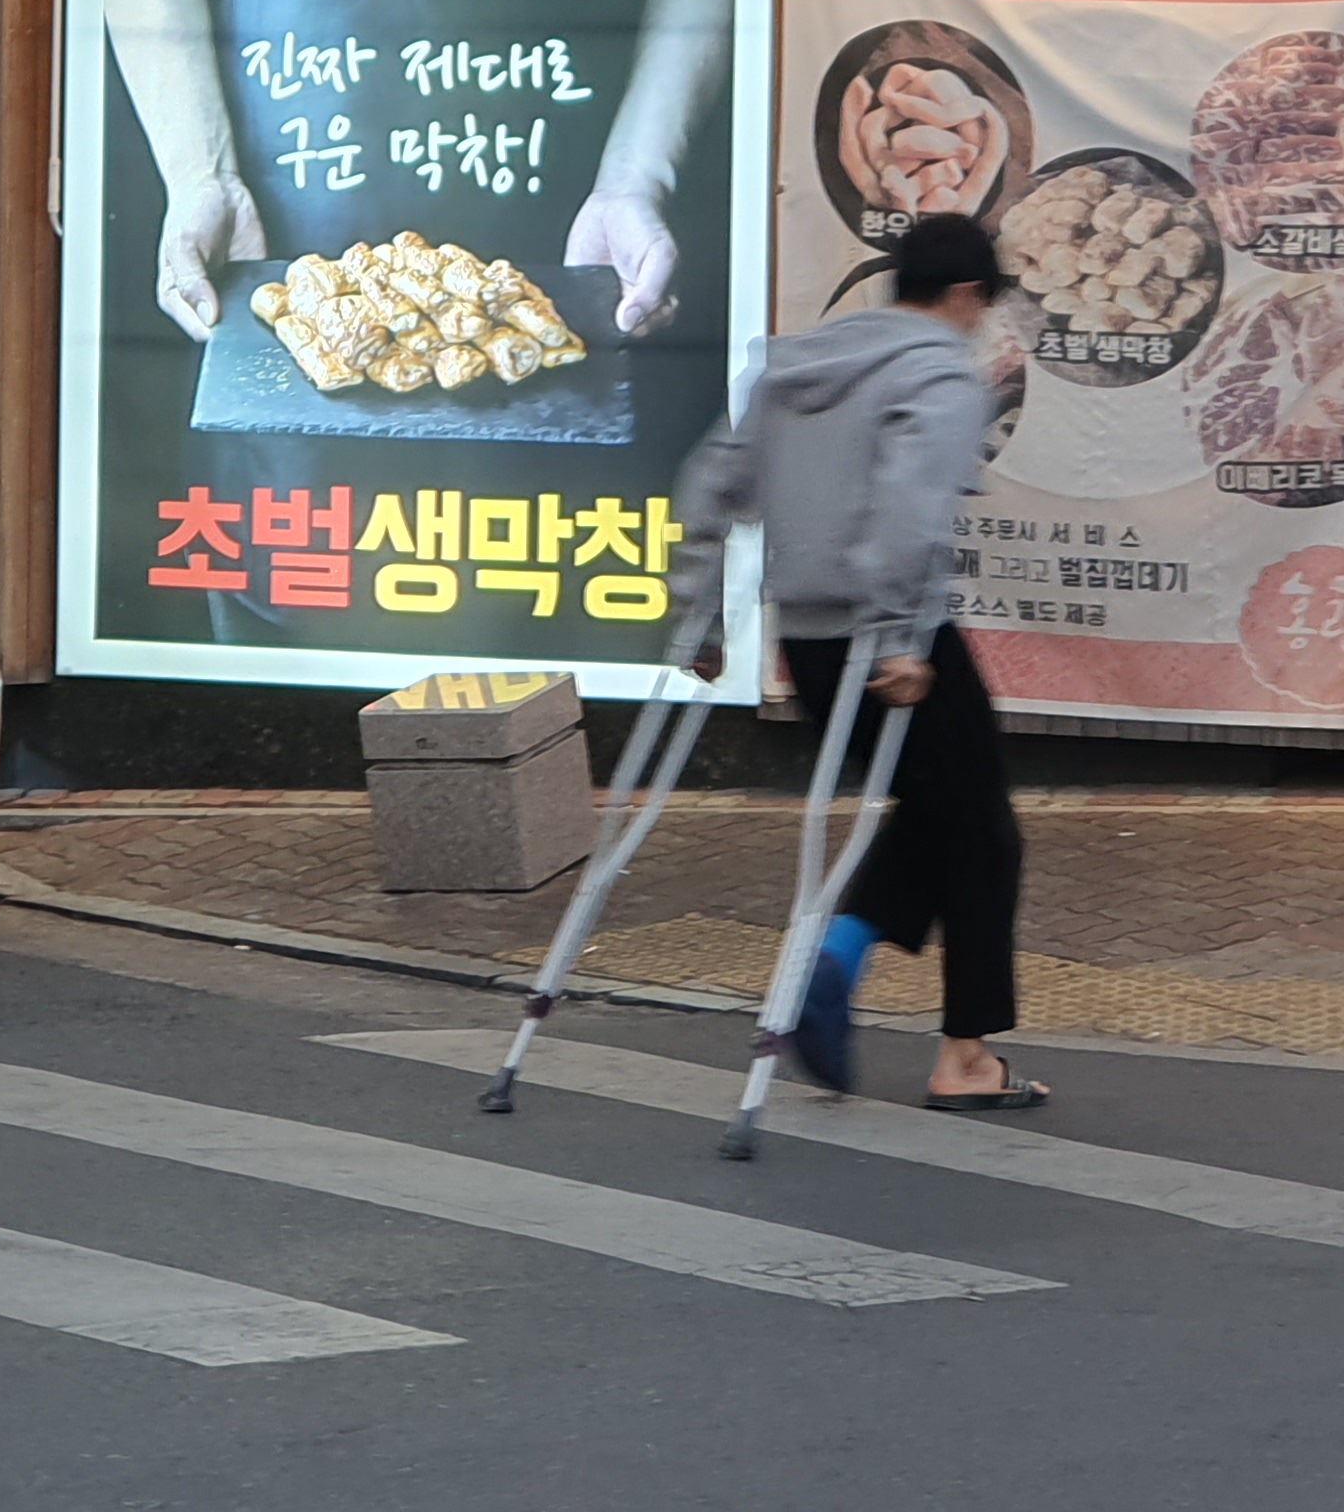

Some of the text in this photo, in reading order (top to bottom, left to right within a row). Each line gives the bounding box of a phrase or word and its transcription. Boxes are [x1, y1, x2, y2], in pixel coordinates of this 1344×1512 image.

[241, 32, 593, 102] 진짜 제대로
[277, 114, 547, 195] 구운 막창!
[1039, 331, 1173, 366] 초벌 생막창
[977, 517, 1038, 541] 주문시
[989, 555, 1052, 583] 그리고
[1058, 556, 1190, 593] 벌집껍데기
[944, 592, 1009, 617] 운소스
[1063, 602, 1108, 627] 제공
